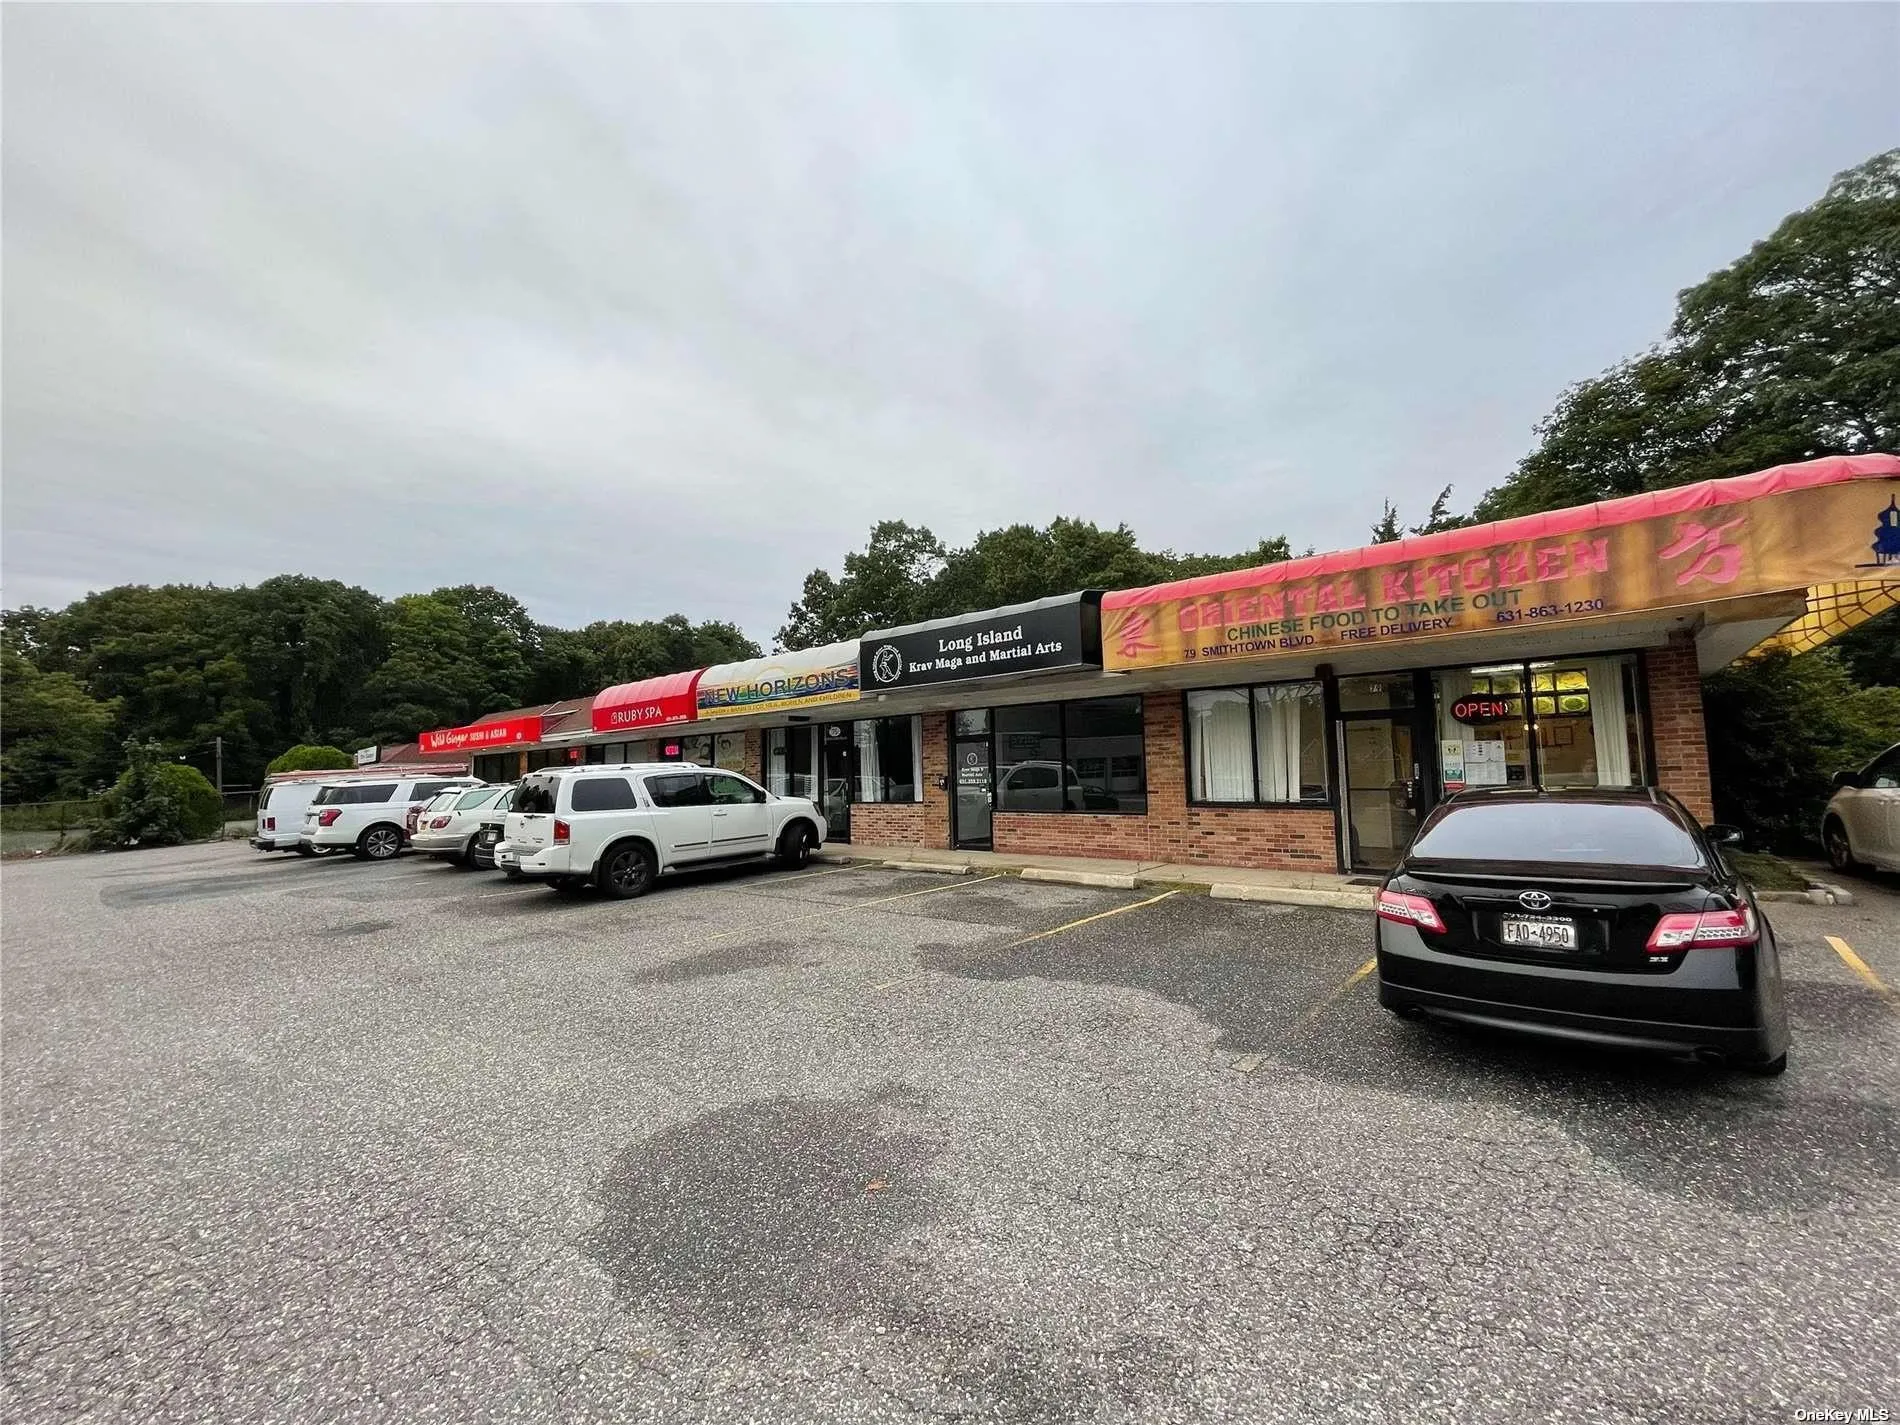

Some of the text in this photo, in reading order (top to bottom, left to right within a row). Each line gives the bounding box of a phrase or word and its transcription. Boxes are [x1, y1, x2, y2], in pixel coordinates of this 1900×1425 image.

[1179, 537, 1609, 632] ORIENTAL KITCHEN
[1227, 589, 1523, 641] CHINESE FOOD TO TAKE OUT
[1496, 598, 1604, 623] 631-863-1230
[938, 626, 1023, 652] Long Island
[1340, 617, 1453, 641] FREE DELIVERY
[909, 641, 1062, 673] Krav Maga and Martial Arts
[1184, 634, 1317, 659] 79 SMITHTOWN BLVD.
[704, 668, 850, 704] NEW HORIZONS
[618, 708, 644, 723] RUBY
[644, 705, 663, 719] SPA
[1455, 702, 1503, 717] OPEN
[430, 732, 445, 748] Wild
[445, 731, 468, 748] Ginger
